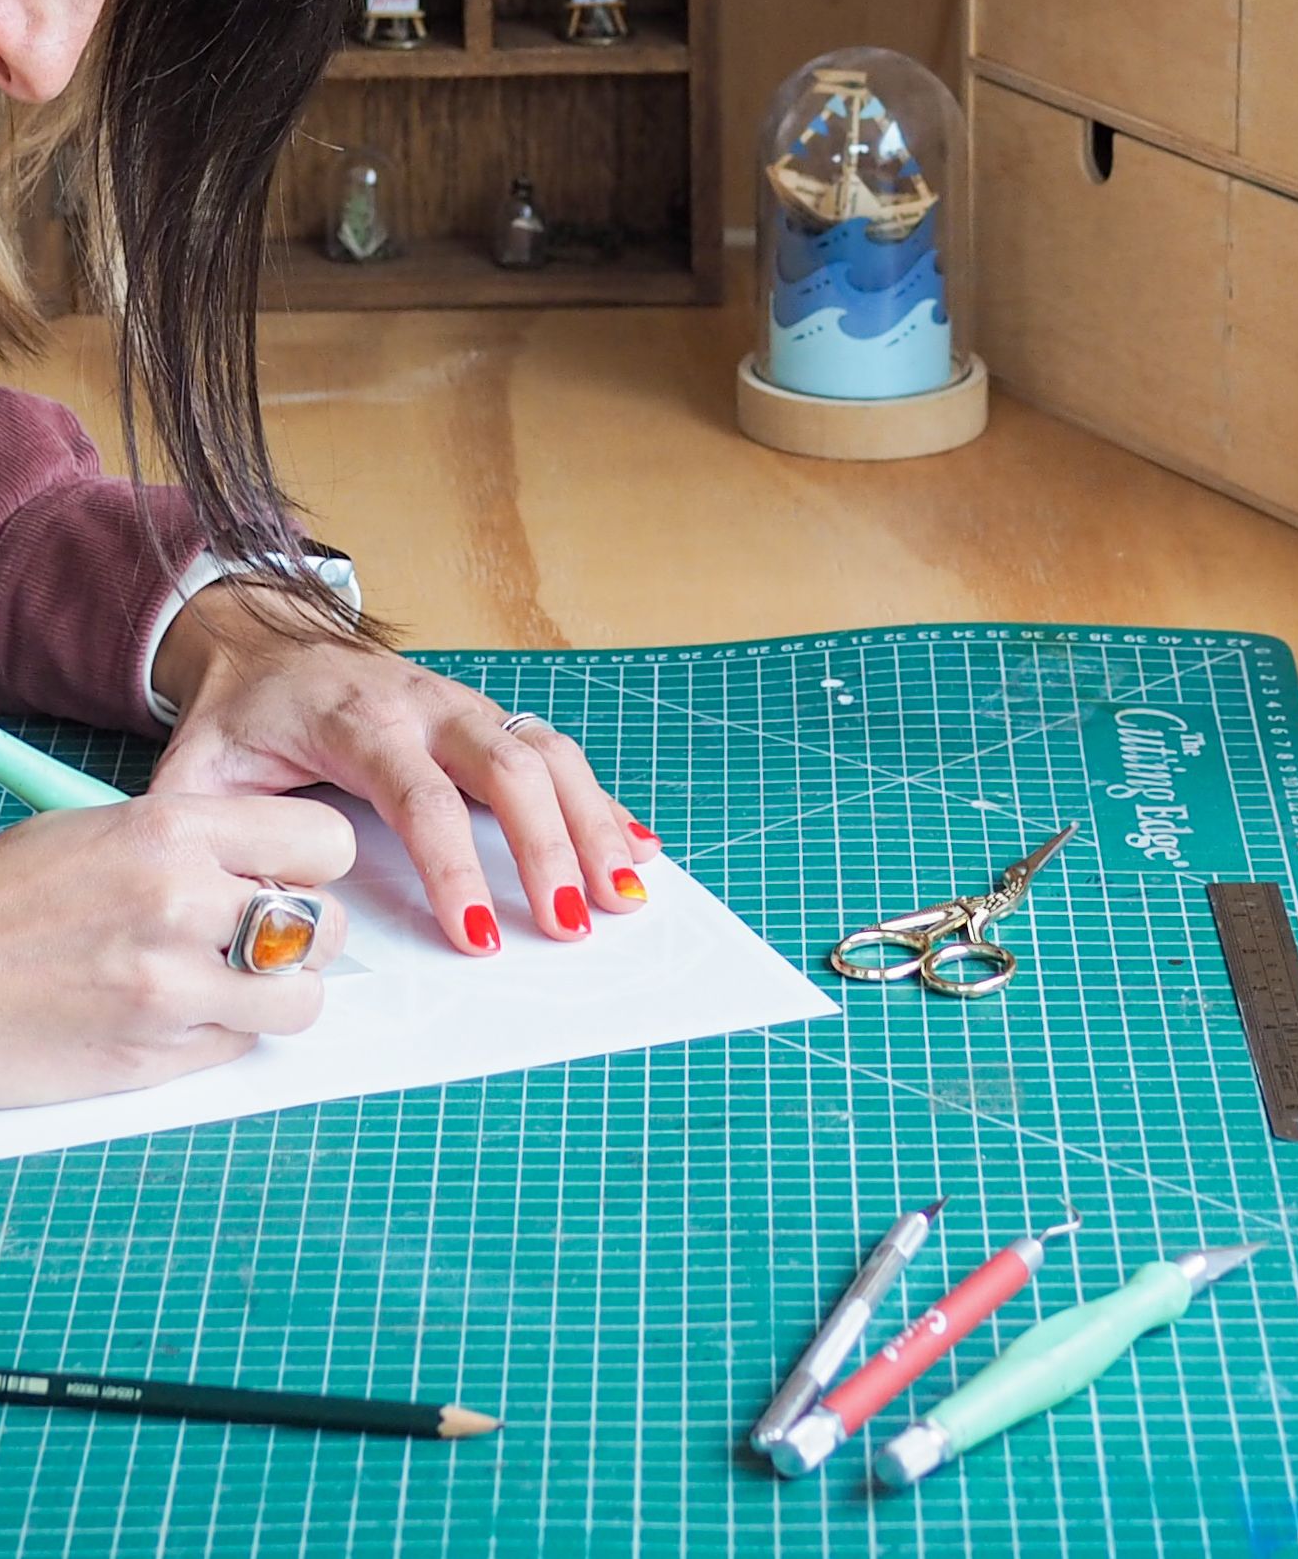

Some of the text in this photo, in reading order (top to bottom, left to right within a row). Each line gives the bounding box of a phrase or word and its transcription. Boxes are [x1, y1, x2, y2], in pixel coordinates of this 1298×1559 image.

[473, 656, 498, 664] 20
[510, 656, 532, 664] 21
[542, 656, 566, 664] 22
[576, 655, 600, 664] 23
[611, 654, 635, 663] 24
[644, 653, 669, 662] 25
[678, 651, 702, 660] 26
[712, 648, 737, 658] 27
[746, 646, 771, 656] 28
[780, 642, 804, 653] 29
[814, 639, 839, 649] 30
[850, 635, 873, 645] 31
[883, 632, 907, 642] 32
[916, 630, 942, 640] 33
[951, 629, 976, 639] 34
[986, 629, 1011, 639] 35
[1020, 630, 1045, 640] 36
[1055, 632, 1079, 641] 37
[1089, 633, 1112, 642] 38
[1123, 634, 1147, 644] 39
[1157, 635, 1182, 645] 40
[1192, 636, 1217, 646] 41
[1226, 638, 1252, 648] 42
[1180, 731, 1206, 757] The
[1105, 707, 1195, 861] Cutting Edge
